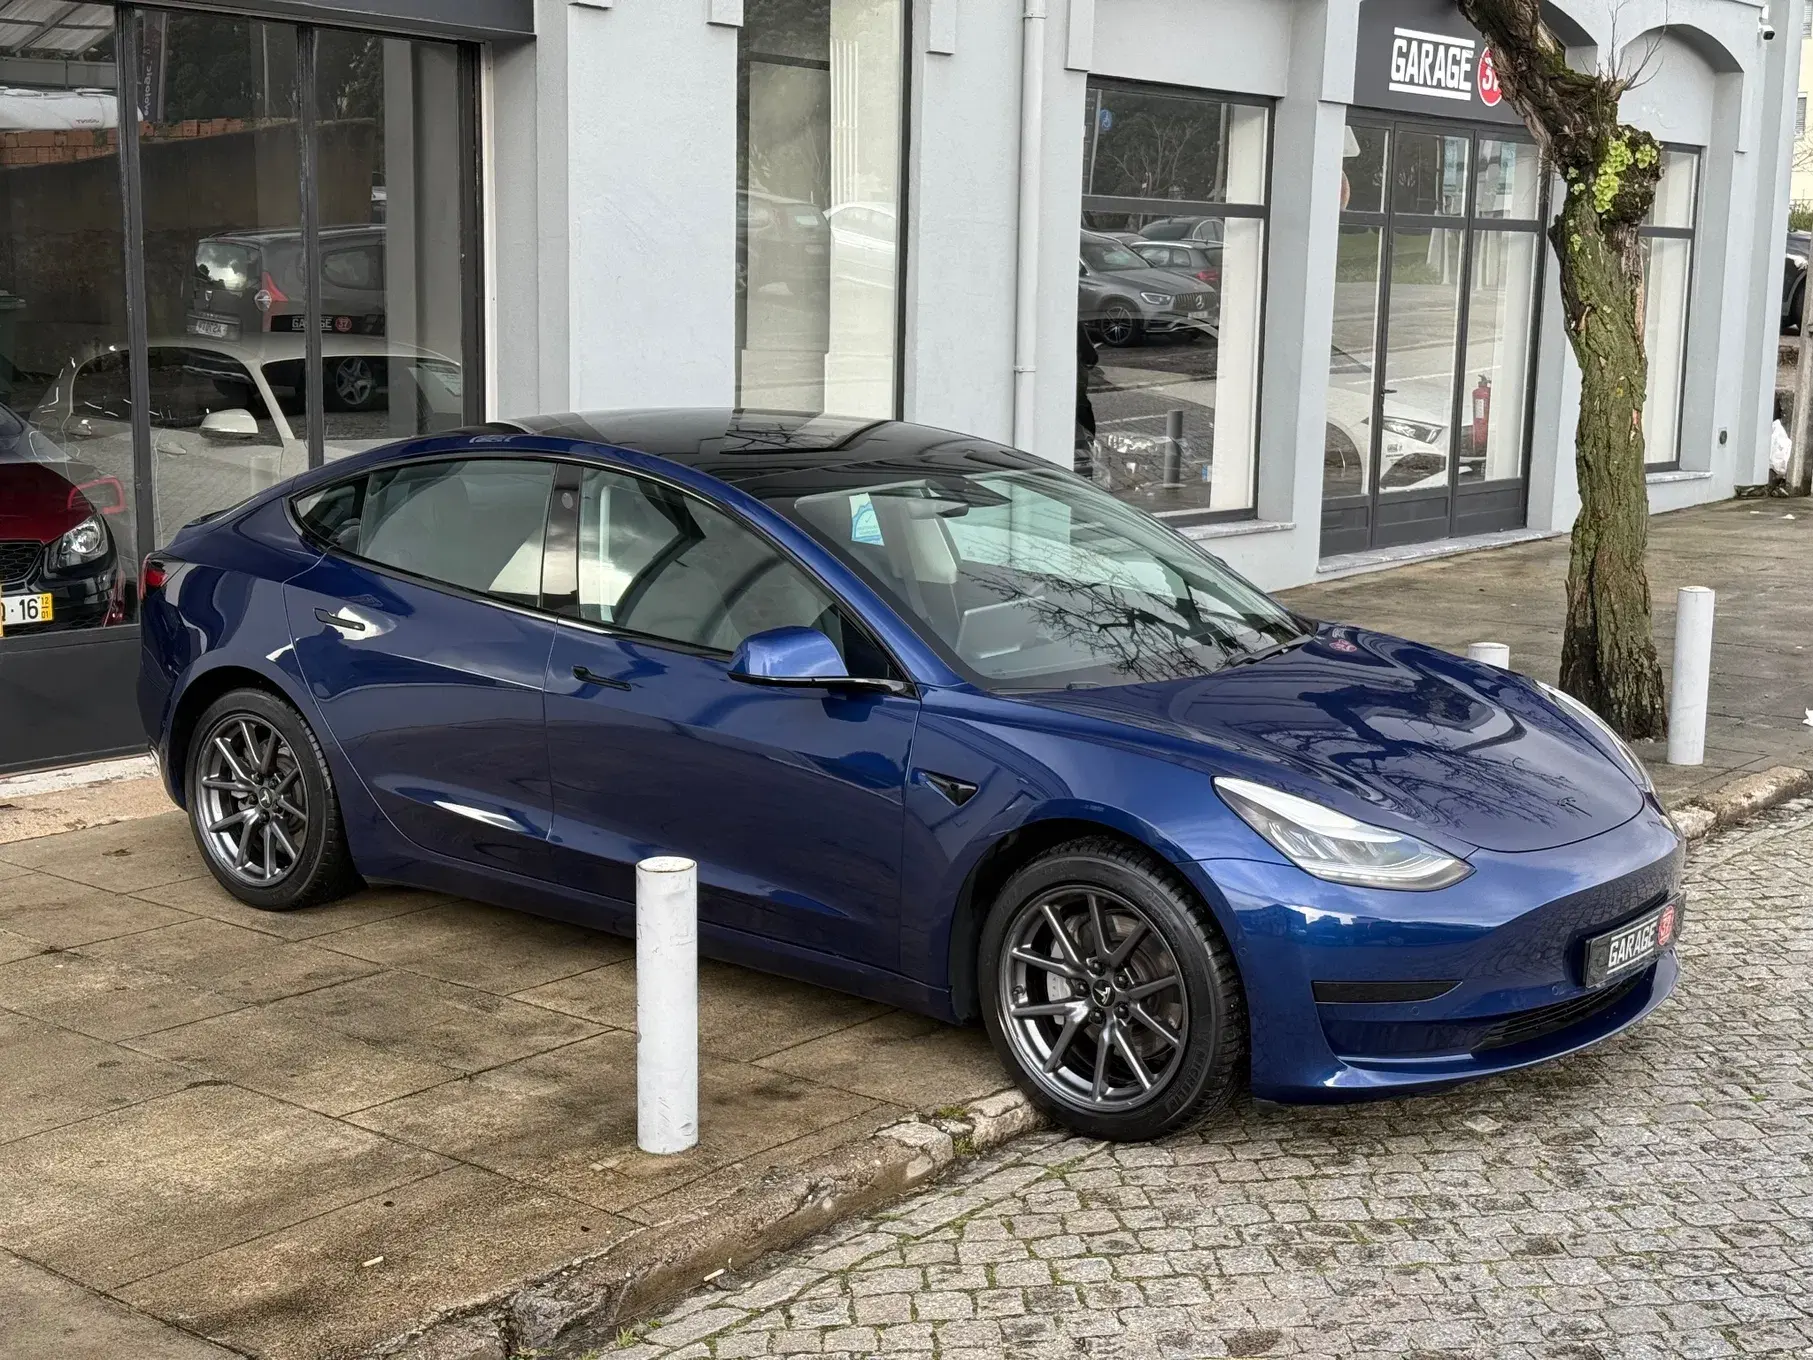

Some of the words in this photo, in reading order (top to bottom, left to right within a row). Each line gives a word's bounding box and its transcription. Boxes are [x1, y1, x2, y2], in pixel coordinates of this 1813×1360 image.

[1391, 38, 1474, 91] GARAGE
[292, 318, 332, 328] GAGE
[41, 597, 49, 605] 12
[41, 611, 49, 619] 01
[1608, 921, 1657, 967] GARAGE
[1168, 1048, 1207, 1110] MICHELIN
